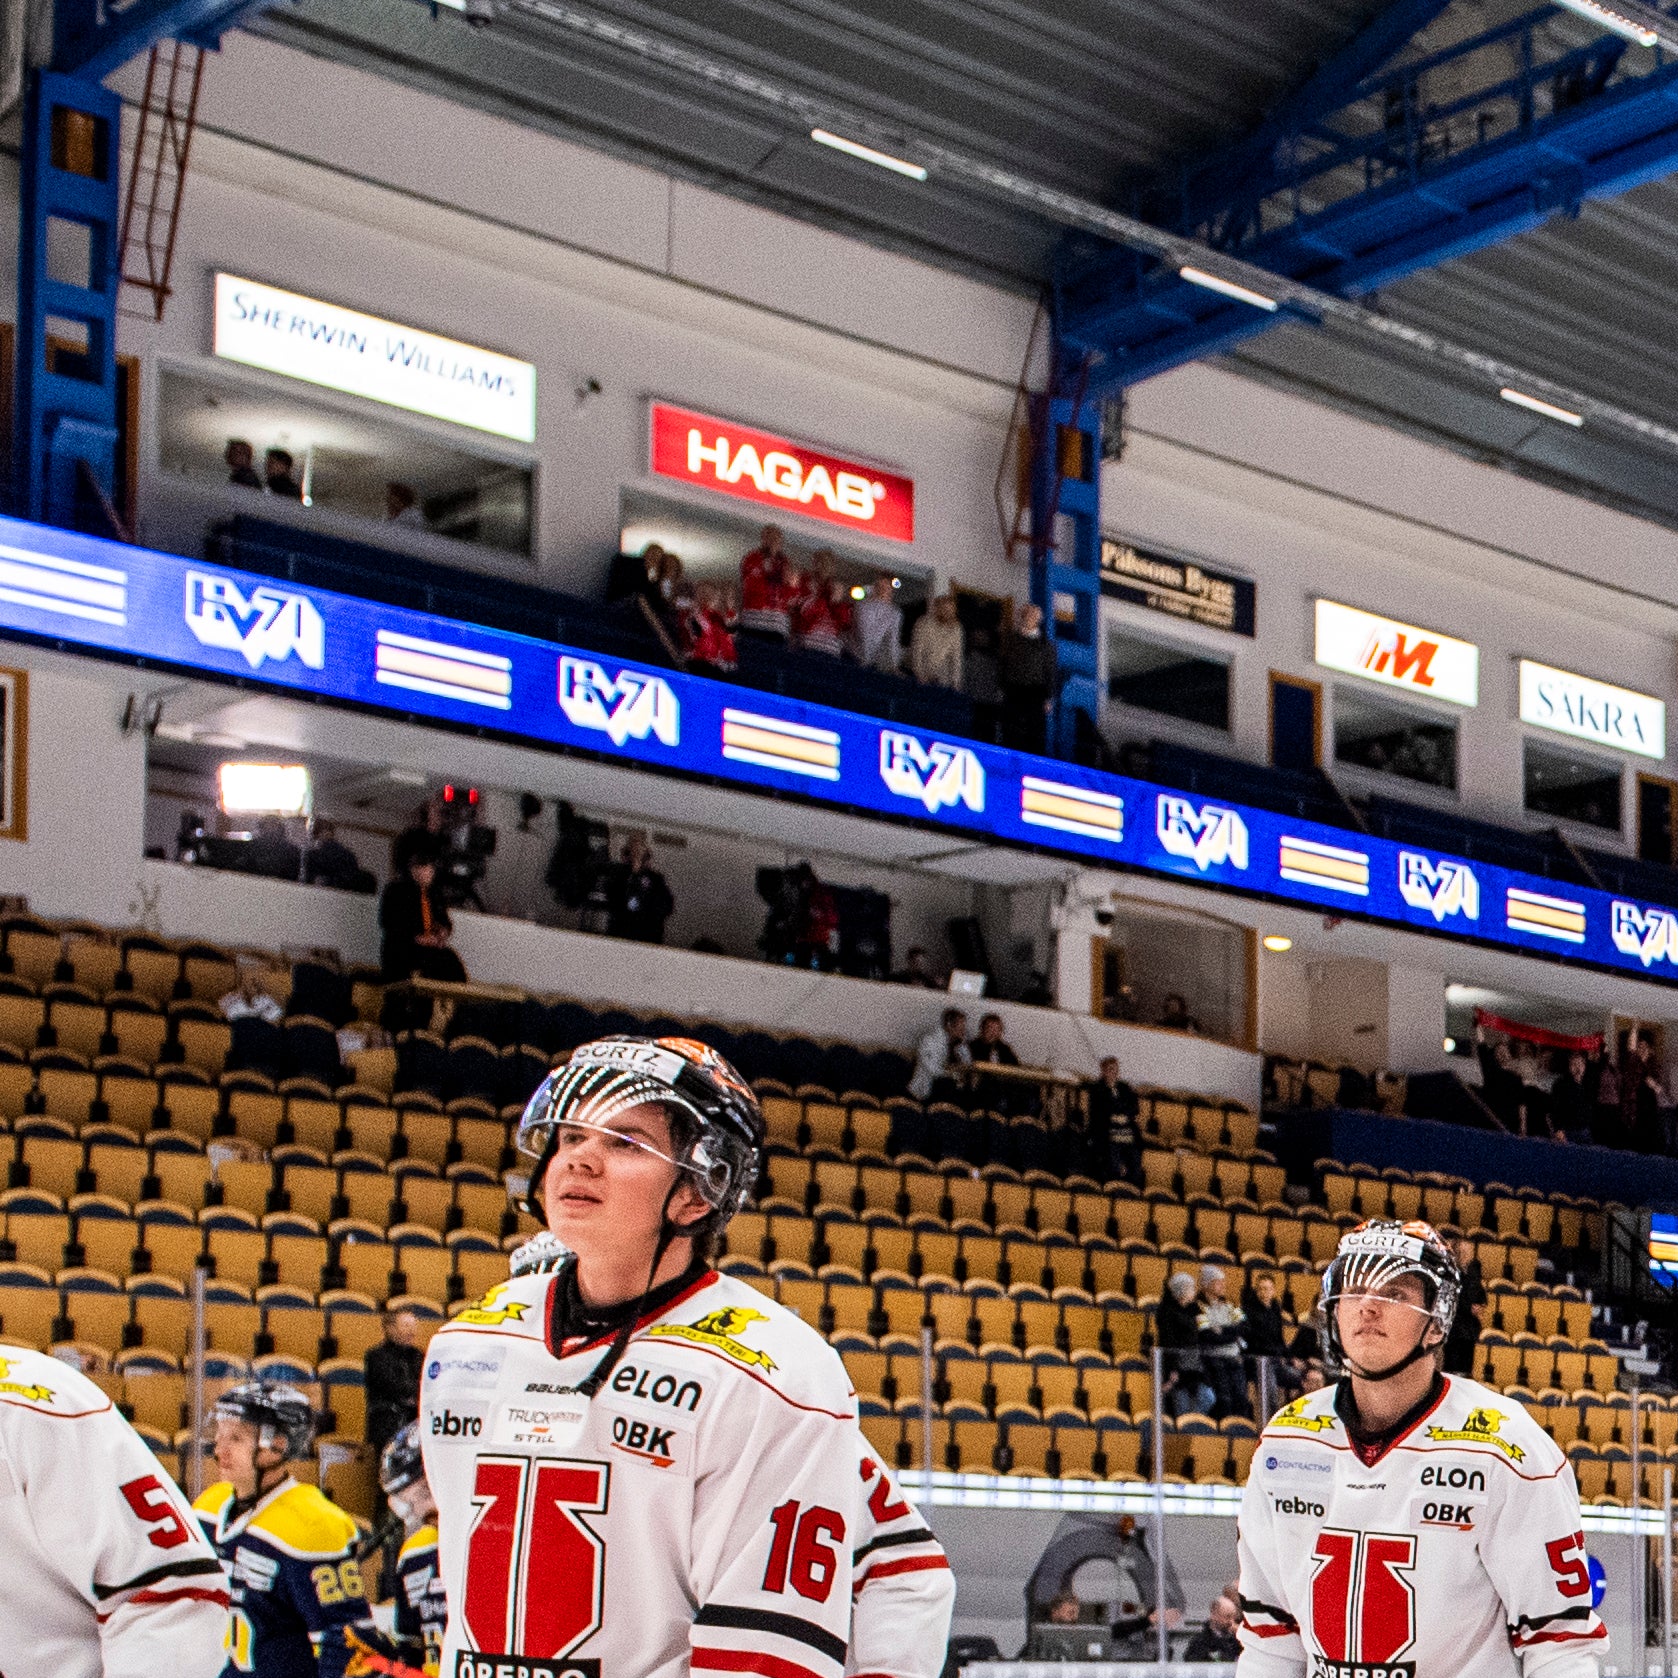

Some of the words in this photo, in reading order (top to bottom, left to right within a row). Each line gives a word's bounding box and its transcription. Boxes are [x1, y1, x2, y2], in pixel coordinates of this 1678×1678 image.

[684, 427, 874, 521] HAGAB
[1537, 677, 1646, 744] SÄKRA
[612, 1416, 677, 1459] OBK
[1274, 1496, 1326, 1518] rebro
[1422, 1502, 1474, 1524] OBK
[761, 1499, 848, 1604] 16
[310, 1560, 365, 1606] 26
